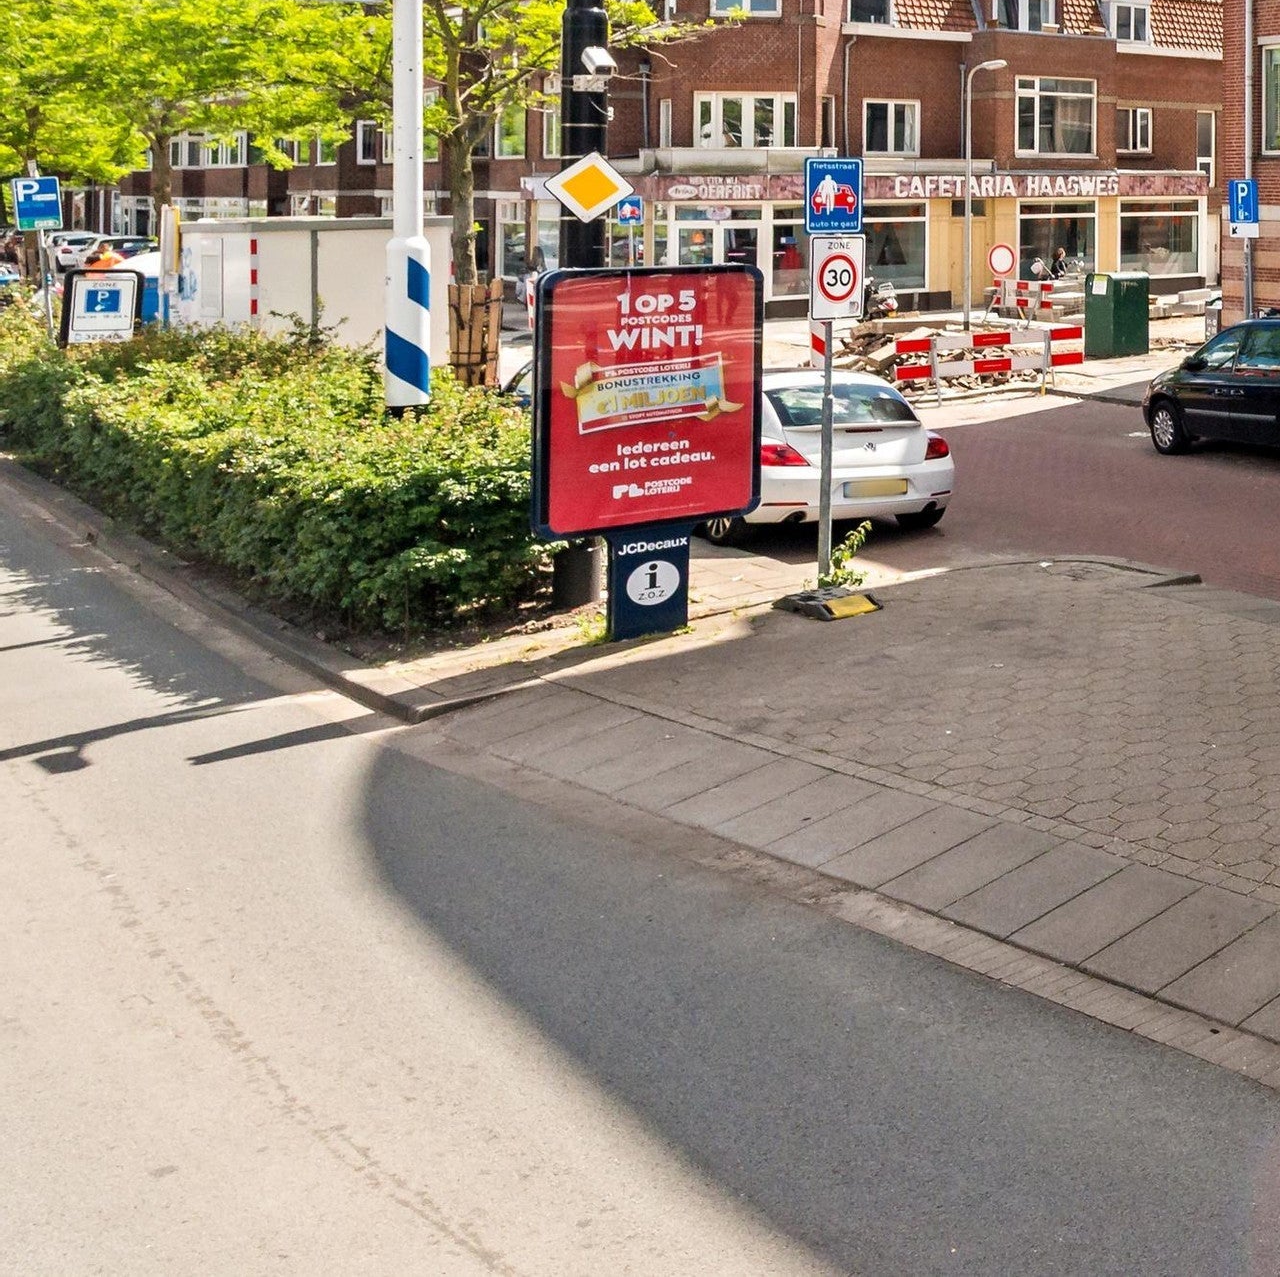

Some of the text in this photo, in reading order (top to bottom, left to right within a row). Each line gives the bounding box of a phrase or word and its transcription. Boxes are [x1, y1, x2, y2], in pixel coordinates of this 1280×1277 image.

[812, 162, 856, 171] fietsstraat
[16, 180, 39, 202] P
[894, 174, 1119, 197] CAFETARIA HAAGWEG
[1237, 183, 1248, 204] P
[841, 220, 858, 229] gast
[828, 241, 851, 250] ZONE
[826, 269, 851, 287] 30
[97, 291, 109, 303] P
[617, 290, 697, 314] 1 OP 5
[621, 314, 692, 326] POSTCODES
[607, 325, 704, 351] WINT!
[617, 365, 660, 376] POSTCODE
[597, 372, 701, 391] BONUSTREKKING
[622, 385, 707, 410] MILJOEN
[589, 450, 715, 474] een lot cadeau.
[644, 477, 692, 488] POSTCODE
[644, 485, 680, 496] LOTERIJ
[618, 537, 688, 556] JCDecaux
